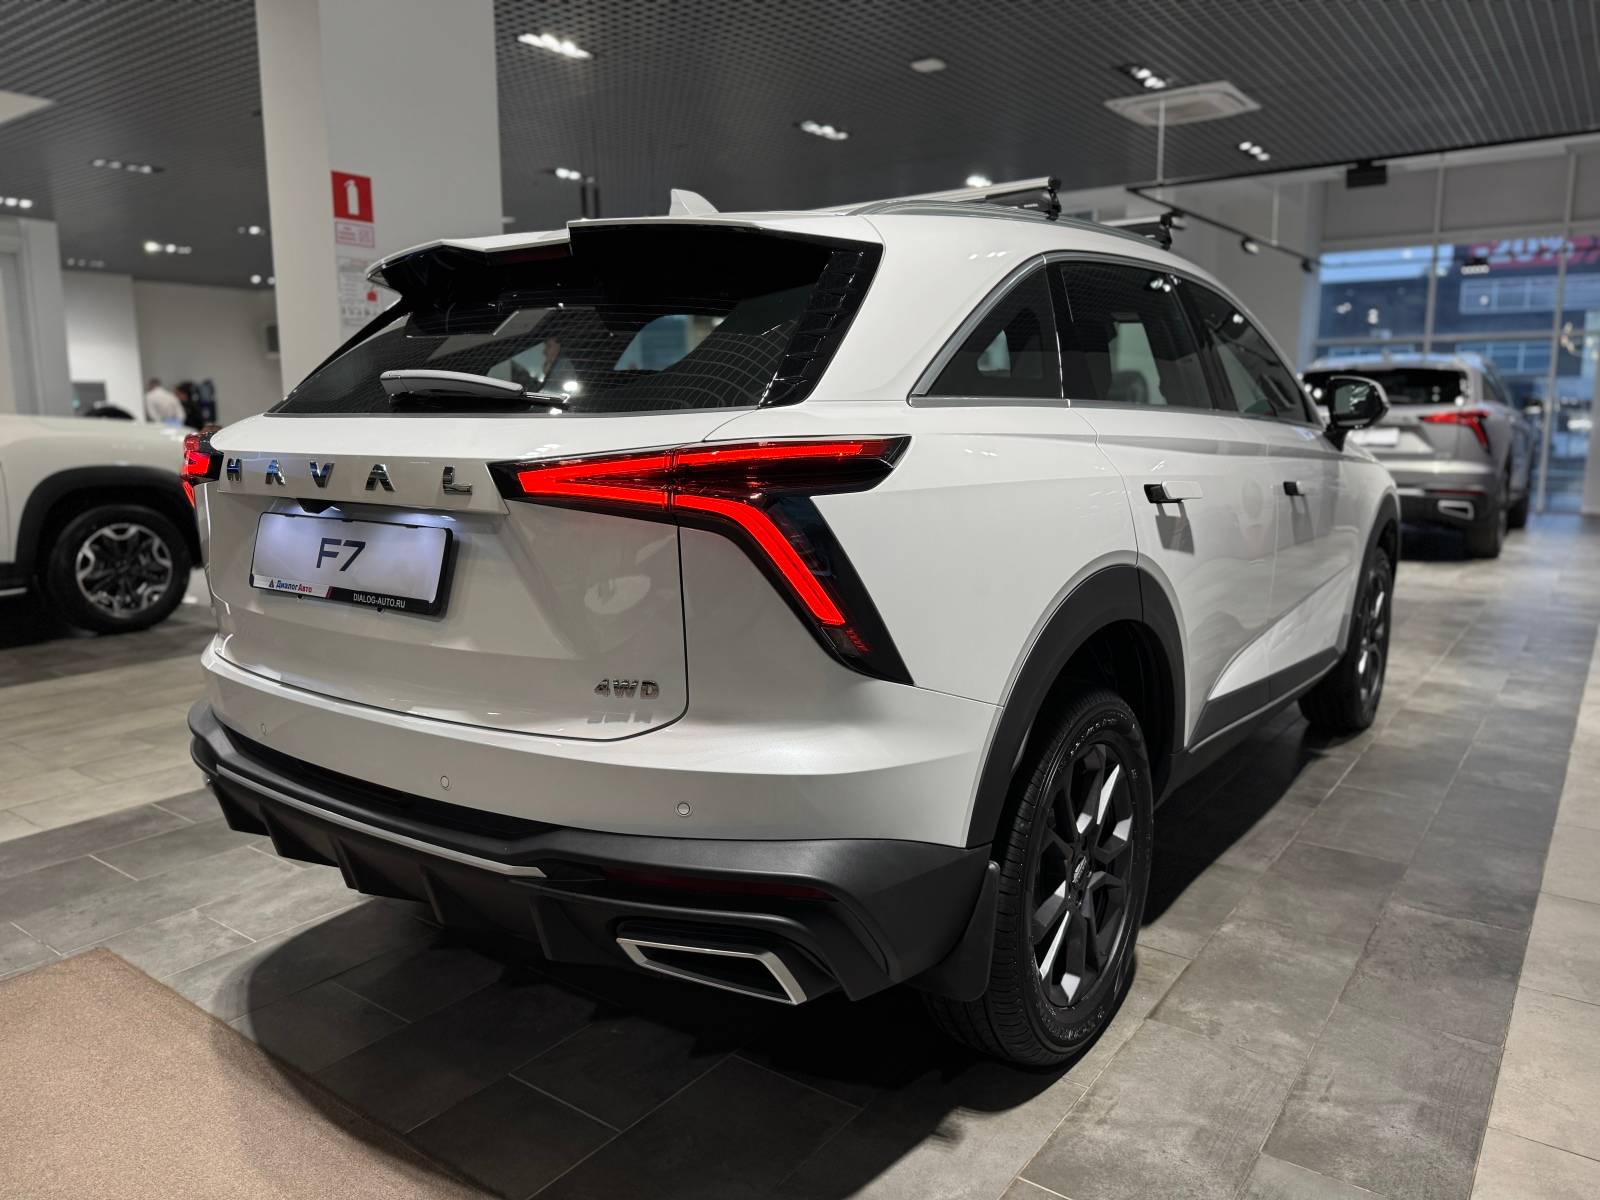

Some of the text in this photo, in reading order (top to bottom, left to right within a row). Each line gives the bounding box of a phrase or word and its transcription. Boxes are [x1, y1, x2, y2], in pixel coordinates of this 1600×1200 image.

[226, 458, 473, 495] HAVAL
[316, 537, 366, 572] F7
[353, 592, 406, 609] DIALOG-AUTO.RU
[594, 679, 659, 699] 4WD
